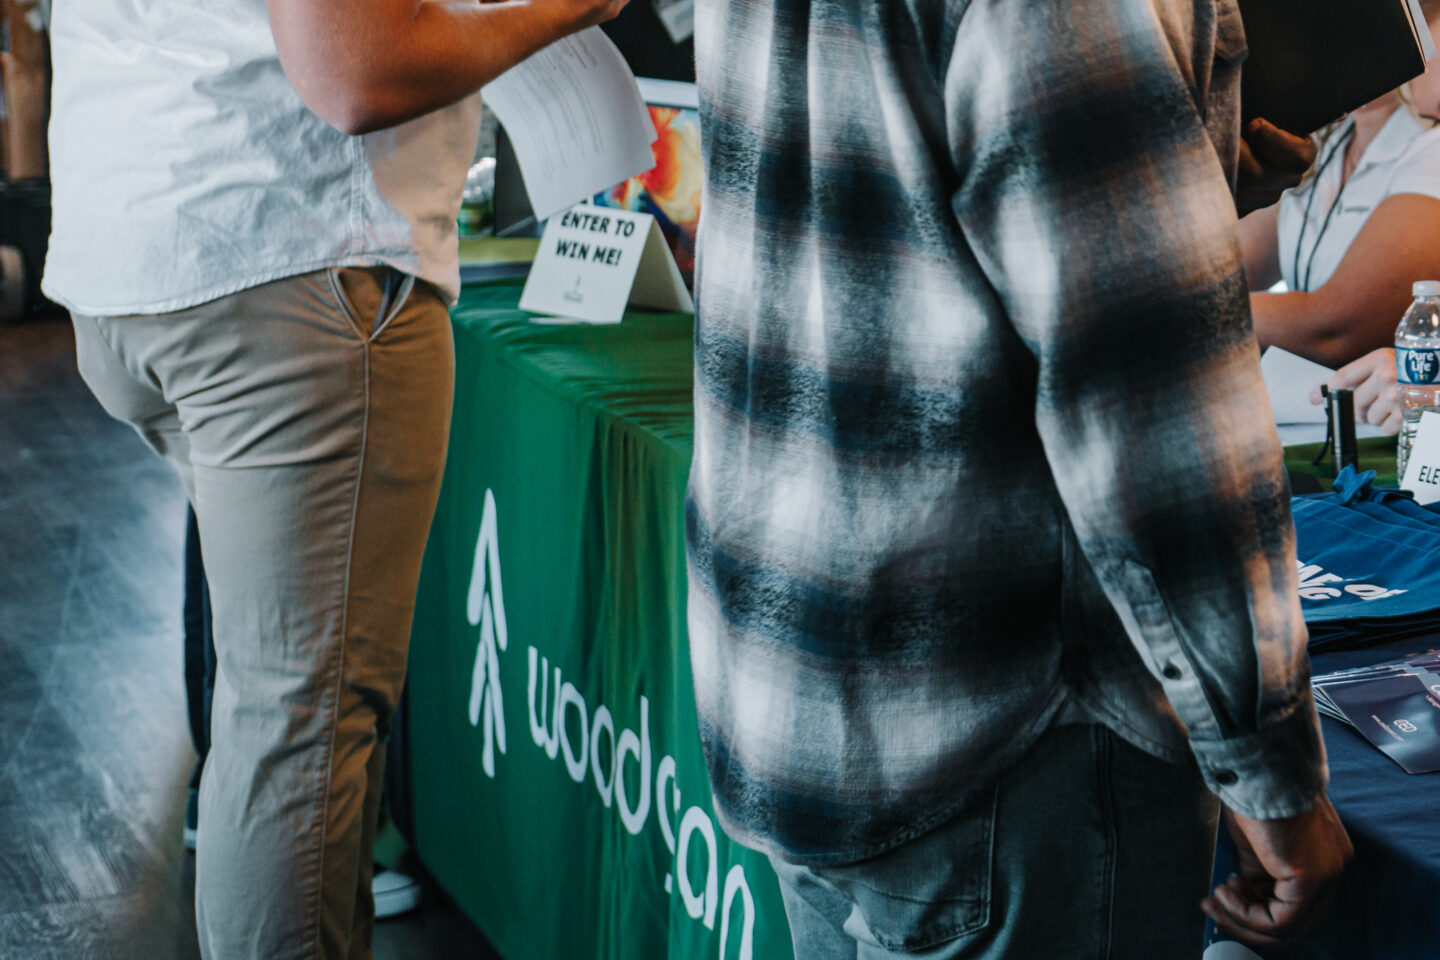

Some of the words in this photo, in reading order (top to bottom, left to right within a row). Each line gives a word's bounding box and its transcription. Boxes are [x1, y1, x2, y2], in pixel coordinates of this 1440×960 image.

[561, 210, 611, 234] ENTER
[615, 220, 636, 238] TO
[555, 239, 590, 261] WIN
[592, 246, 622, 267] ME!
[1408, 349, 1434, 361] Pure
[1411, 360, 1431, 374] Life
[1393, 719, 1418, 733] CED
